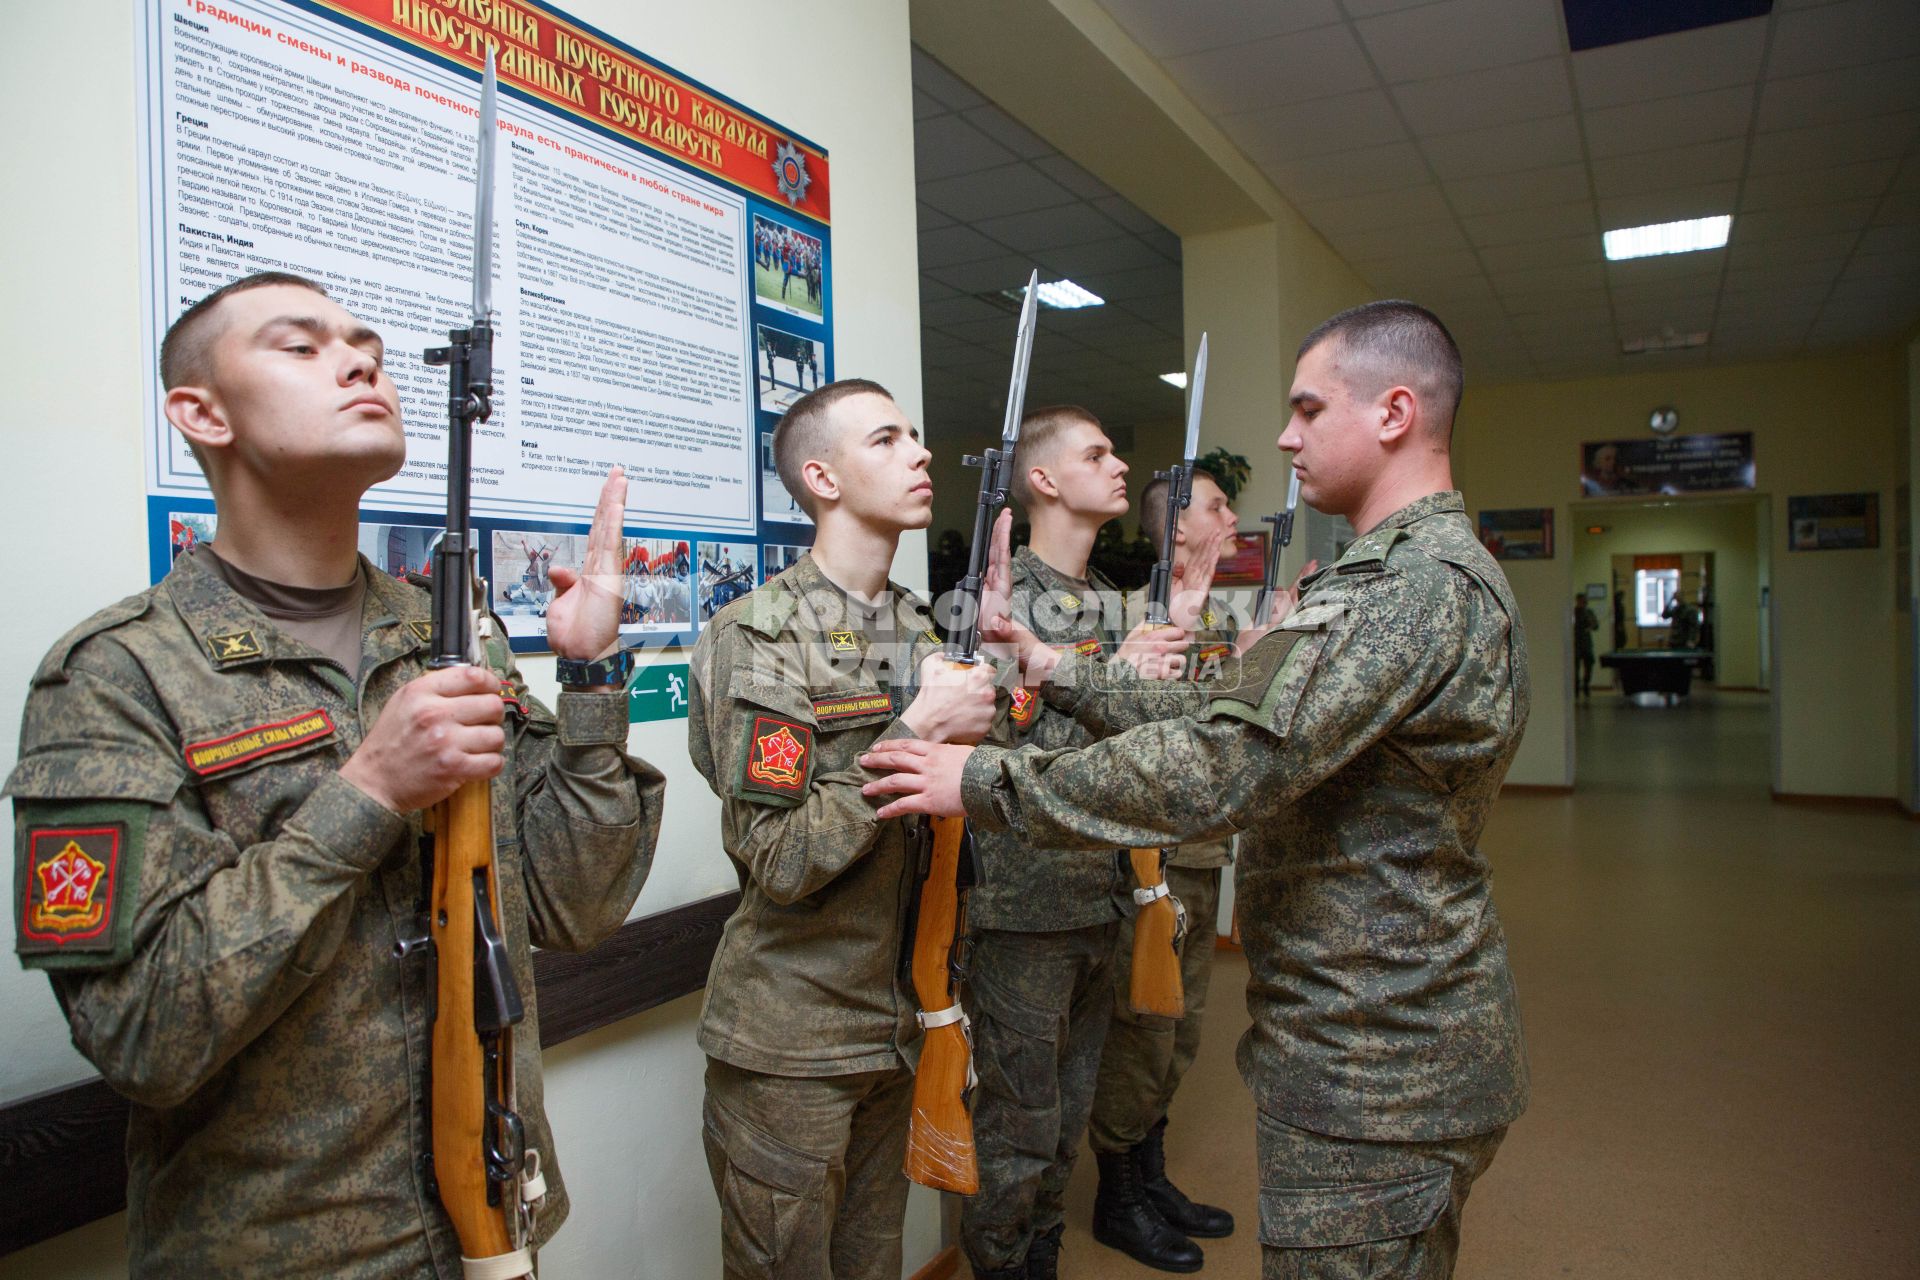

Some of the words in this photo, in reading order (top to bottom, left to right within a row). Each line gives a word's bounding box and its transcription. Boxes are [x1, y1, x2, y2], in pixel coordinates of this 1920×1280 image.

[173, 12, 209, 36] Швеция
[174, 25, 238, 58] Военнослужащие
[240, 49, 283, 75] королевской
[284, 67, 304, 82] армии
[306, 73, 331, 92] Швеции
[174, 39, 222, 65] королевство,
[228, 59, 260, 79] сохраняя
[262, 69, 305, 94] нейтралитет,
[306, 87, 314, 96] не
[315, 90, 349, 110] принимало
[434, 0, 540, 50] ЛЕНИЯ
[555, 28, 680, 116] ПОЧЕТНОГО
[691, 97, 768, 160] КАРАУЛА
[174, 52, 204, 71] увидеть
[264, 84, 308, 107] королевского
[313, 101, 336, 117] дворца
[339, 110, 358, 124] рядом
[174, 65, 193, 80] день
[203, 75, 233, 94] полдень
[235, 86, 267, 105] проходит
[270, 98, 320, 123] торжественная
[322, 116, 342, 129] смена
[183, 0, 272, 38] Традиции
[277, 32, 332, 61] смены
[337, 55, 346, 67] и
[351, 60, 411, 91] развода
[415, 85, 481, 119] почетного
[537, 133, 561, 152] есть
[565, 145, 628, 180] практически
[631, 173, 638, 183] в
[639, 176, 669, 195] любой
[672, 188, 701, 208] стране
[703, 200, 724, 218] мира
[175, 92, 208, 109] сложные
[210, 103, 259, 127] перестроения
[267, 120, 295, 137] высокий
[296, 131, 324, 147] уровень
[324, 138, 342, 152] своей
[176, 110, 209, 131] Греция
[599, 84, 723, 169] ГОСУДАРСТВ
[183, 126, 210, 144] Греции
[211, 134, 246, 153] почетный
[247, 147, 271, 162] караул
[273, 154, 298, 168] состоит
[300, 162, 308, 171] из
[334, 171, 356, 185] Эвзони
[206, 145, 233, 163] Первое
[237, 156, 279, 176] упоминание
[282, 167, 291, 178] об
[294, 171, 321, 187] Эвзонес
[324, 180, 351, 197] найдено
[511, 138, 535, 156] Ватикан
[176, 151, 222, 171] опоясанные
[263, 174, 273, 185] На
[274, 179, 314, 198] протяжении
[315, 191, 334, 204] веков,
[336, 196, 359, 209] словом
[177, 162, 214, 183] греческой
[216, 173, 239, 188] легкой
[277, 190, 293, 202] 1914
[294, 196, 309, 208] года
[310, 199, 333, 213] Эвзони
[334, 207, 353, 218] стала
[177, 176, 209, 194] Гвардию
[211, 186, 246, 202] называли
[247, 196, 256, 205] то
[259, 197, 304, 219] Королевской,
[308, 212, 315, 220] то
[318, 213, 348, 230] Гвардией
[177, 202, 209, 218] Эвзонес
[217, 213, 250, 230] солдаты,
[251, 220, 292, 240] отобранные
[294, 232, 302, 240] из
[303, 233, 332, 248] обычных
[178, 222, 225, 243] Пакистан,
[226, 234, 254, 250] Индия
[239, 205, 291, 228] Президентская
[296, 221, 322, 236] гвардия
[325, 228, 333, 237] не
[336, 231, 357, 243] только
[178, 236, 203, 251] Индия
[211, 243, 245, 259] Пакистан
[246, 253, 282, 269] находятся
[289, 262, 323, 276] состоянии
[326, 269, 346, 281] войны
[349, 276, 361, 286] уже
[179, 250, 200, 261] свете
[206, 256, 239, 269] является
[179, 262, 222, 281] Церемония
[519, 284, 565, 307] Великобритания
[421, 364, 446, 376] традиция
[521, 437, 537, 448] Китай
[290, 716, 326, 738] РОССИИ
